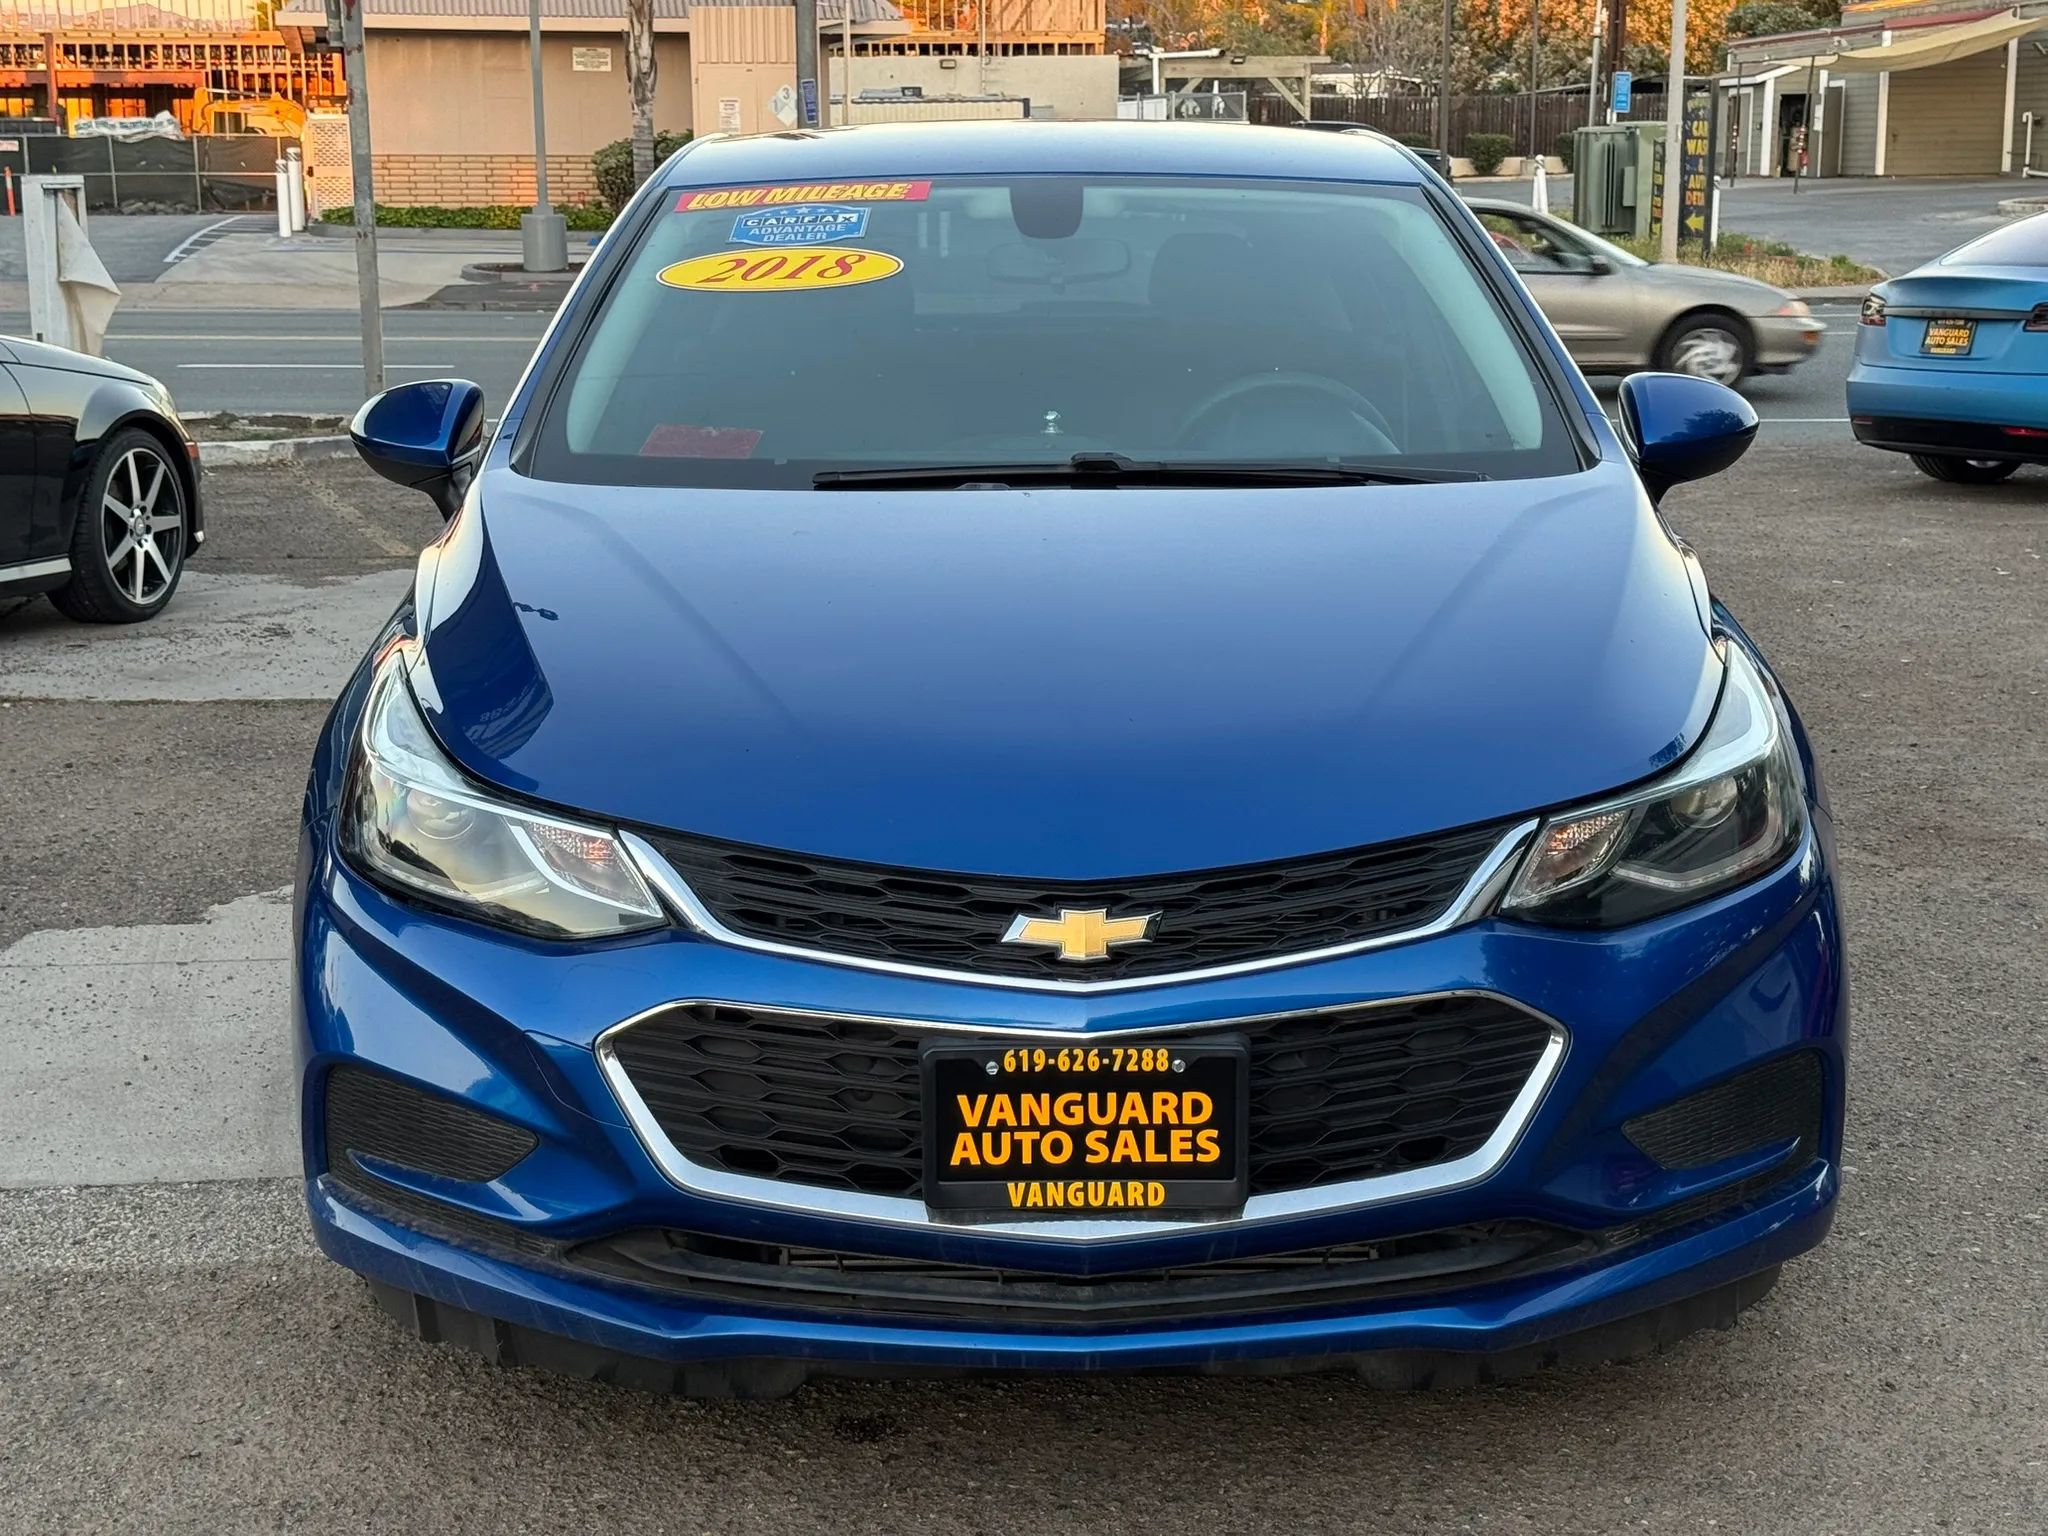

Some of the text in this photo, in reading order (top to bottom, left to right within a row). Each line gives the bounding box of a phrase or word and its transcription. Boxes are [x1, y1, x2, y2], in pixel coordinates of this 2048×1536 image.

[781, 87, 791, 101] 3
[1686, 138, 1709, 156] WAS
[1688, 174, 1708, 190] AUT
[685, 183, 913, 210] LOW MILEAGE
[744, 213, 859, 227] CARFAX
[748, 223, 847, 236] ADVANTAGE
[763, 232, 827, 242] DEALER
[695, 253, 867, 284] 2018
[1924, 336, 1969, 346] AUTO SALES
[1928, 327, 1970, 338] VANGUARD
[1003, 1048, 1169, 1073] 619-626-7288
[956, 1091, 1214, 1128] VANGUARD
[949, 1129, 1221, 1166] AUTO SALES
[1006, 1181, 1167, 1208] VANGUARD
